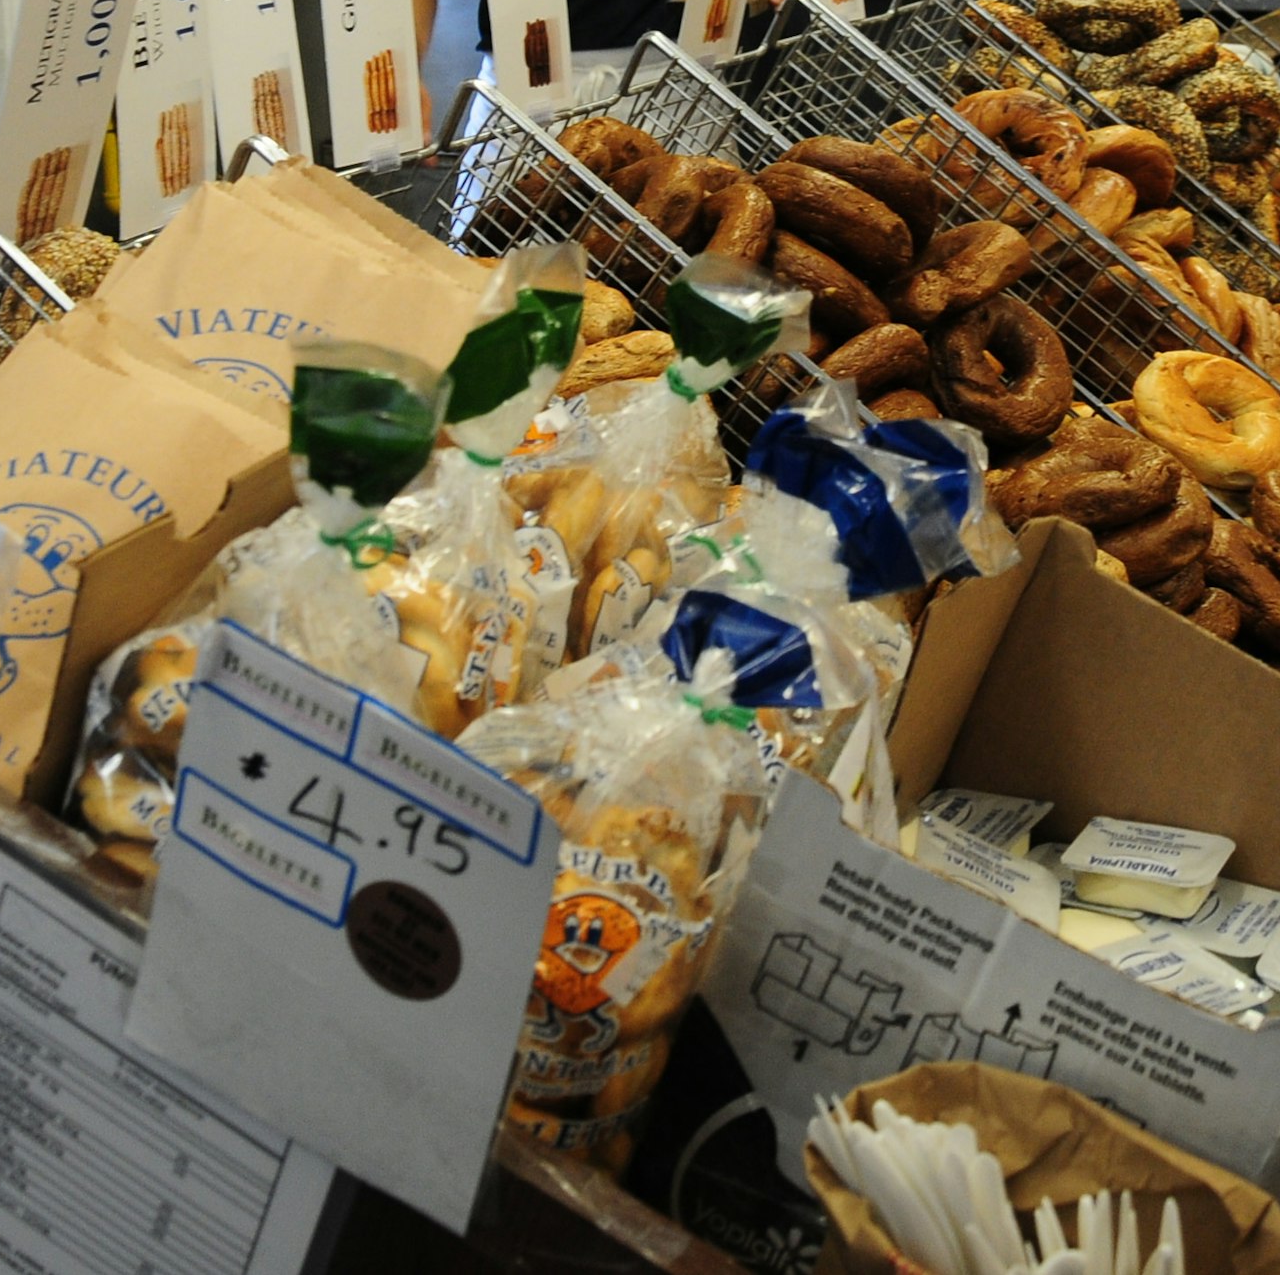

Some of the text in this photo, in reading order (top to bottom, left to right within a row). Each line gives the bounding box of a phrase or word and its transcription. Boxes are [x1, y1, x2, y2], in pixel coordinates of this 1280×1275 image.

[222, 649, 349, 735] BAGELETTE
[379, 736, 511, 828] BAGELETTE
[201, 805, 324, 891] BAGELETTE
[1088, 854, 1178, 878] PHILADELPHIA
[819, 894, 847, 916] and
[847, 908, 898, 944] display
[899, 936, 918, 952] on
[825, 877, 963, 956] Remove this section
[832, 860, 995, 954] Retail Ready Packaging
[1040, 1013, 1056, 1027] et
[1046, 999, 1196, 1079] enlevez cette section
[1054, 980, 1129, 1027] Emballage
[1175, 1040, 1190, 1057] la
